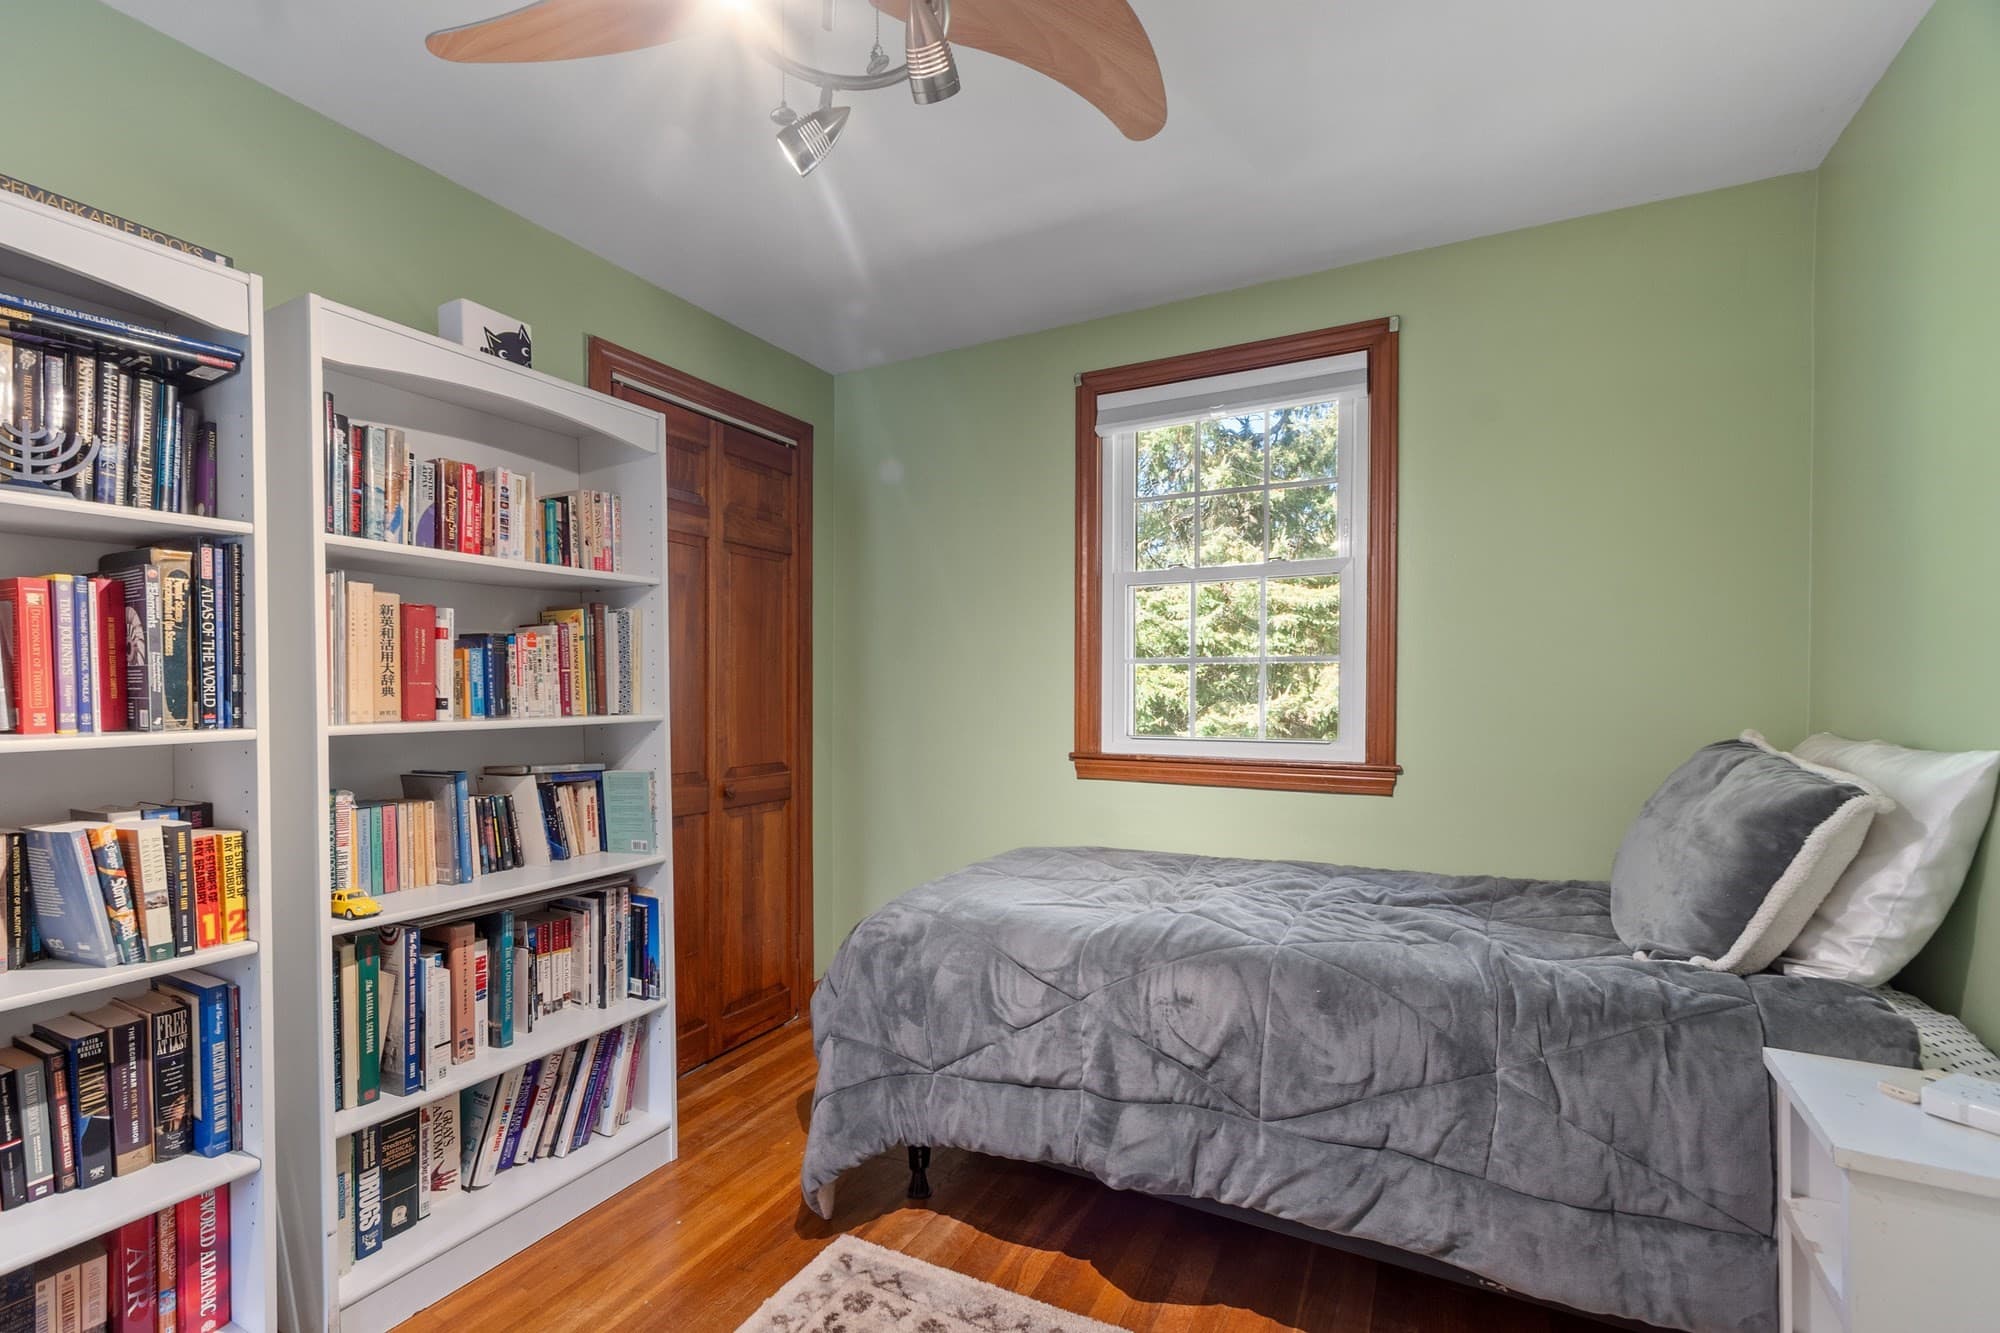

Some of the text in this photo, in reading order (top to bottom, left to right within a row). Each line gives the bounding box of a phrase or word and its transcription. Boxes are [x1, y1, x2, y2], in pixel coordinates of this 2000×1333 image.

[141, 227, 203, 258] BOOKS
[23, 298, 51, 312] MAPS
[51, 304, 78, 319] FROM
[103, 373, 118, 411] SCIENCE
[60, 598, 72, 623] TIME
[146, 588, 158, 629] Elements
[31, 608, 42, 656] DICTIONARY
[202, 585, 216, 708] ATLAS OF THE WORLD
[33, 657, 41, 668] OF
[58, 625, 73, 675] JOURNEYS
[194, 840, 207, 905] RAY BRADBURY
[205, 837, 218, 903] THE STORIES OF
[224, 836, 236, 900] RAY BRADBURY
[233, 834, 244, 897] THE STORIES OF
[13, 874, 21, 896] THEORY
[109, 877, 129, 909] Storm
[13, 905, 21, 937] RELATIVITY
[228, 908, 247, 936] 2
[505, 945, 513, 959] THE
[505, 959, 513, 971] CAT
[505, 971, 513, 997] OWNER'S
[365, 991, 374, 1022] BASEBALL
[127, 1026, 135, 1040] THE
[156, 1009, 188, 1041] FREE
[366, 1022, 374, 1055] SCRAPBOOK
[128, 1042, 137, 1070] SECRET
[156, 1033, 188, 1056] AT LAST
[79, 1062, 107, 1118] LINCOLN
[129, 1071, 138, 1088] WAR
[130, 1089, 138, 1102] FOR
[131, 1119, 139, 1143] UNION
[432, 1106, 445, 1161] ANATOMY
[442, 1109, 456, 1148] GRAY'S
[358, 1165, 381, 1232] DRUGS
[199, 1197, 217, 1317] WORLD ALMANAC
[127, 1247, 151, 1318] AIR
